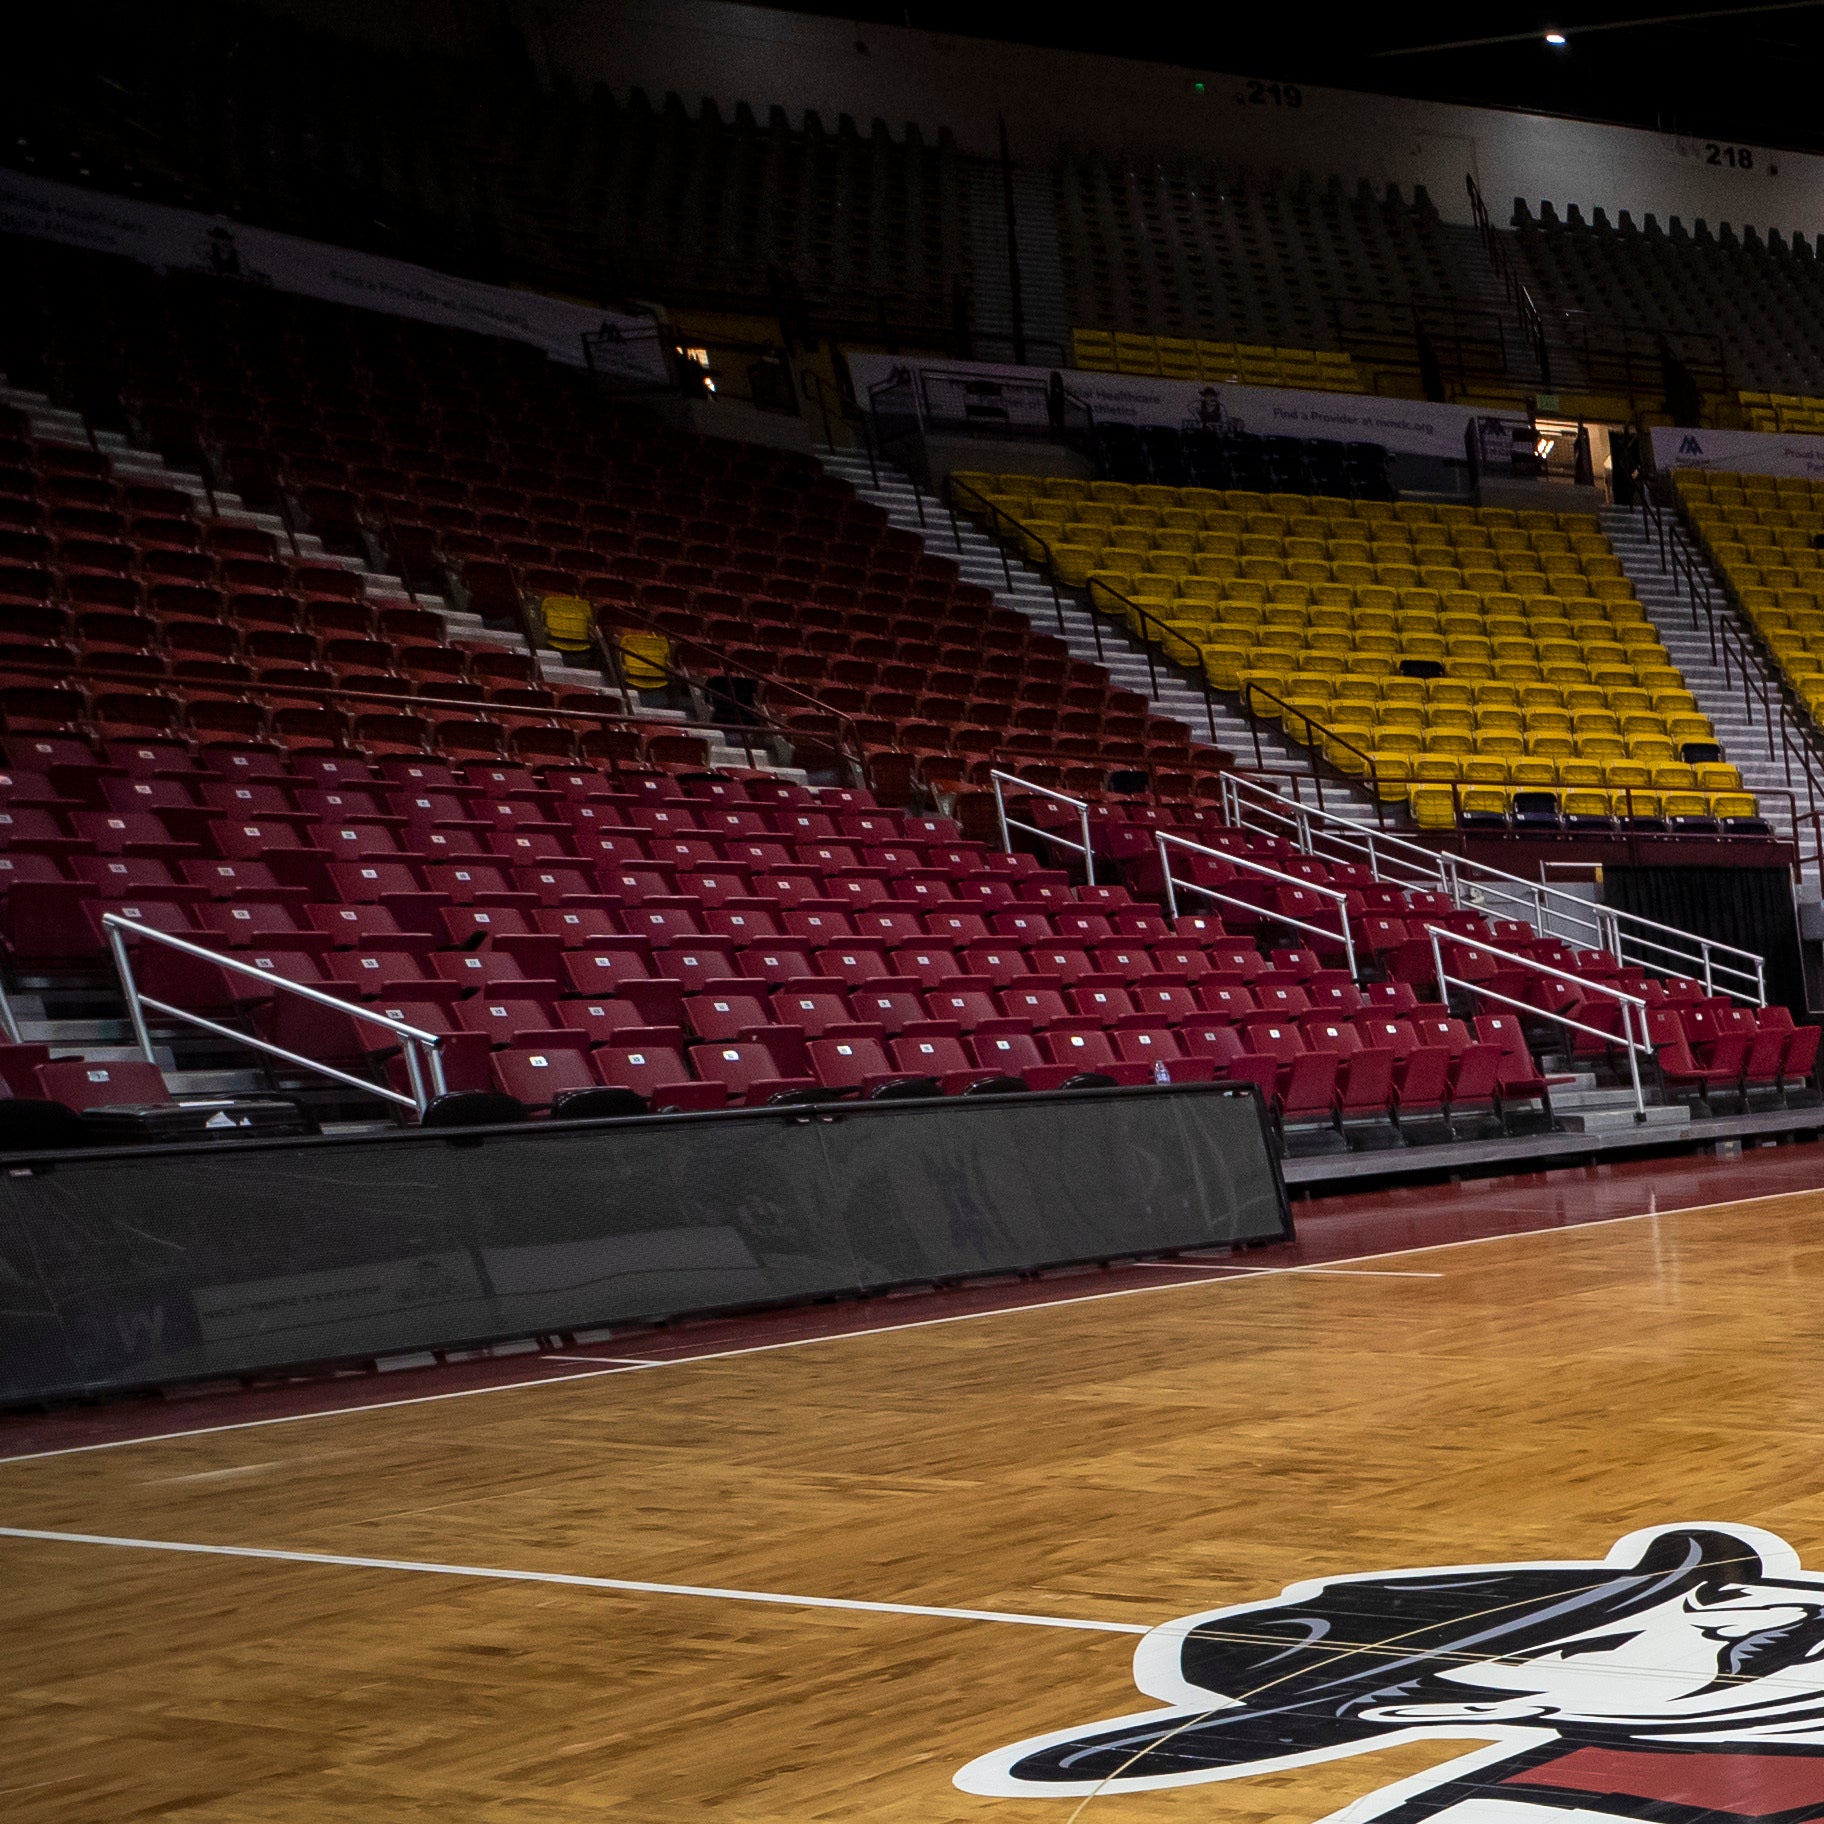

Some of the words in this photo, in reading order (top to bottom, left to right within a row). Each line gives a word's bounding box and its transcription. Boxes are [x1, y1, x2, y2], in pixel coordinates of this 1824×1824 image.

[1248, 80, 1302, 108] 219
[1706, 143, 1753, 170] 218
[1311, 411, 1357, 426] Provider
